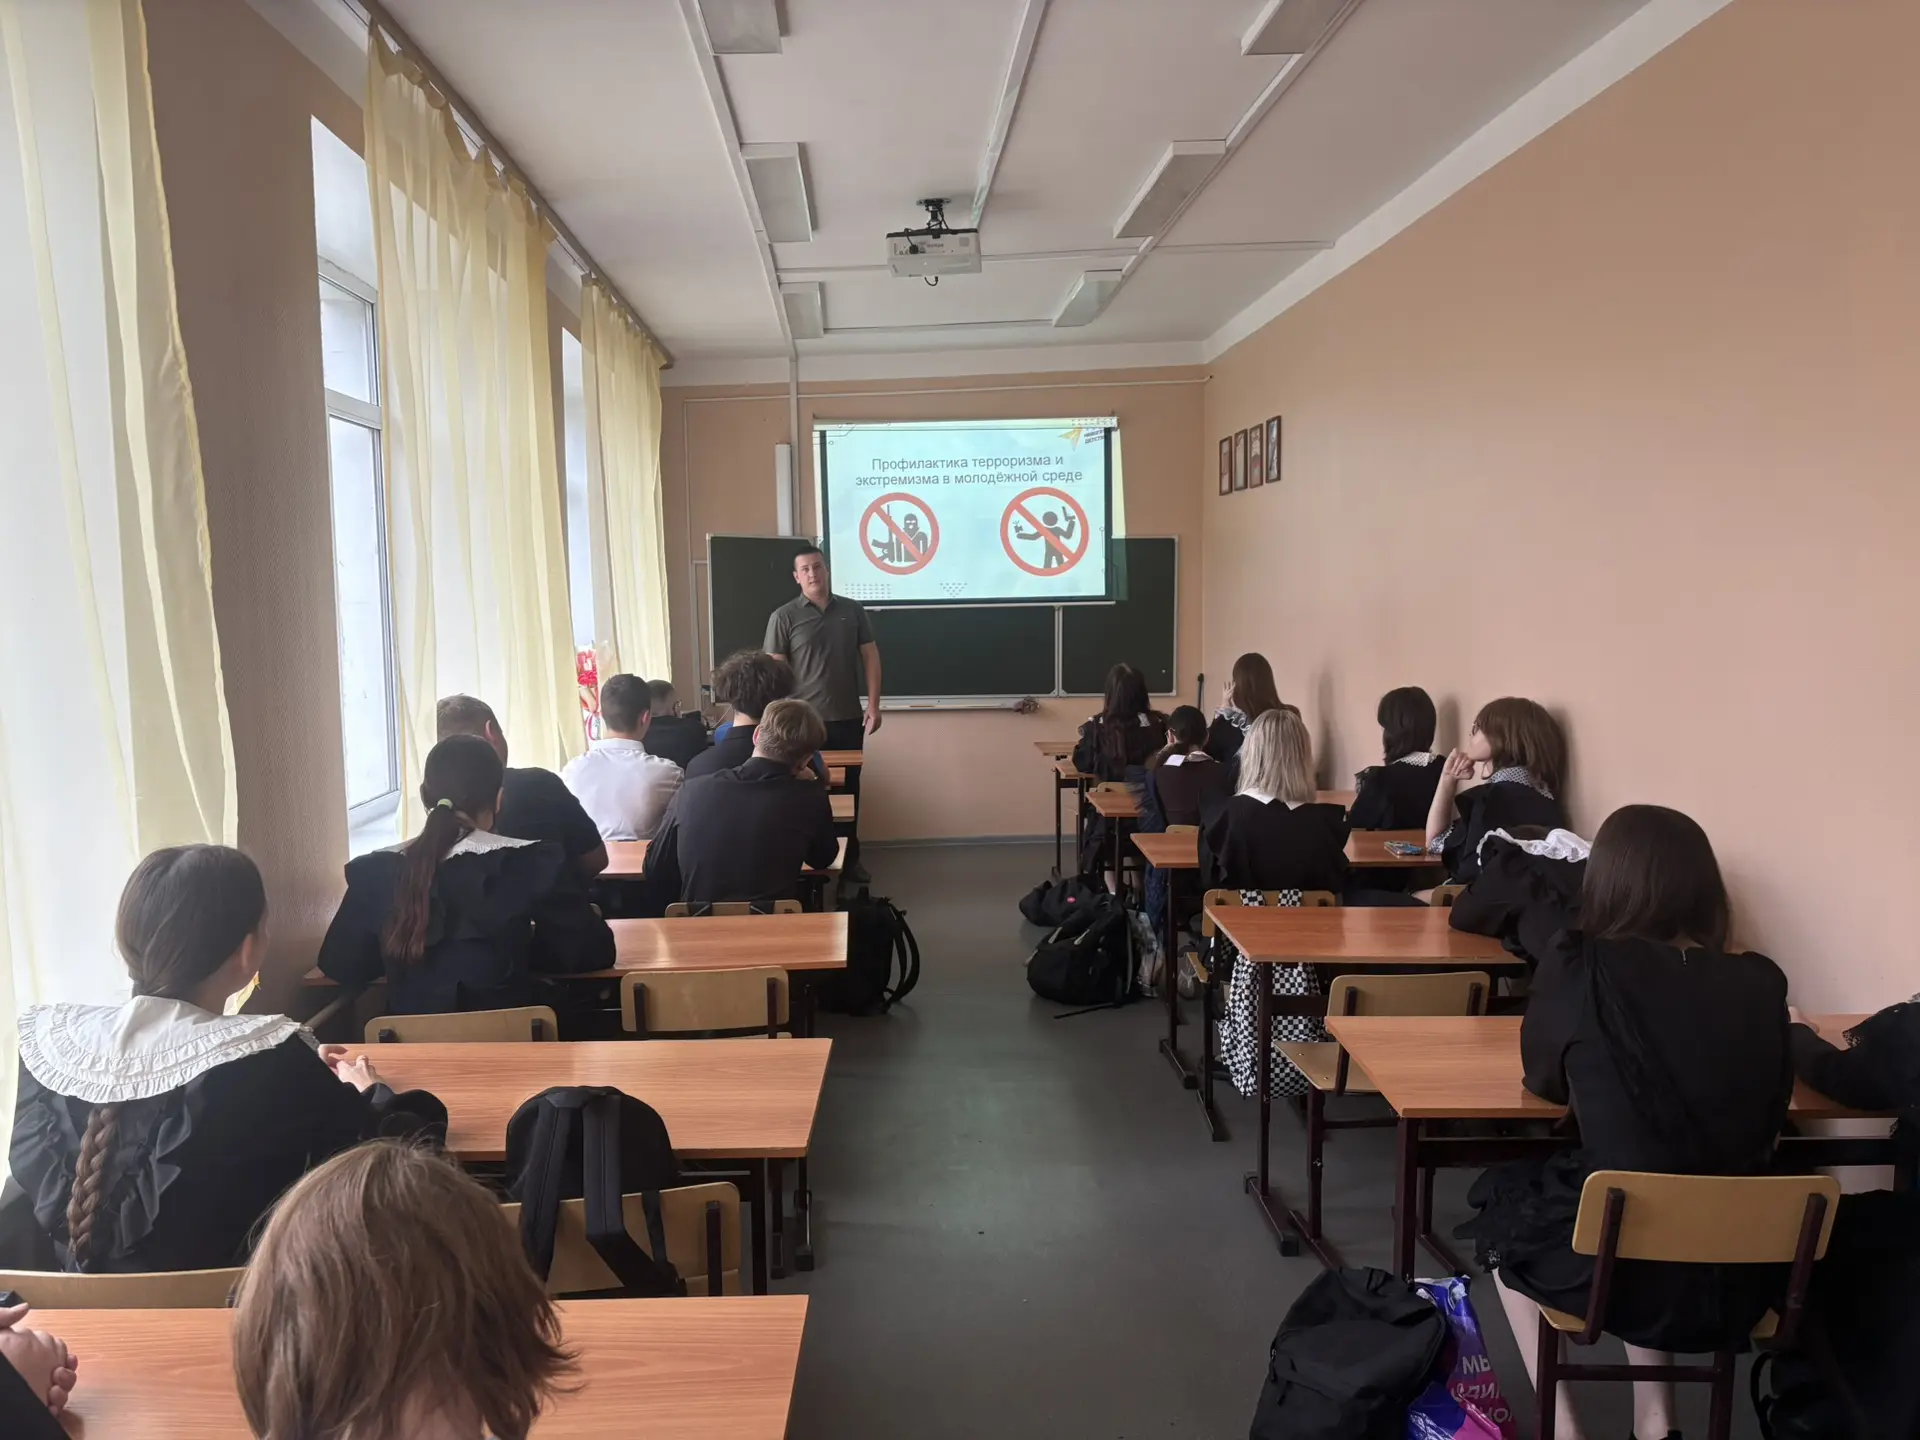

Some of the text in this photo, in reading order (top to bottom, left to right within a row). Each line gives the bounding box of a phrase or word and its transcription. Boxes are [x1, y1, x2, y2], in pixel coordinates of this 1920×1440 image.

[872, 455, 1064, 473] Профилактика терроризма и
[855, 470, 1083, 489] экстремизма в молодёжной среде
